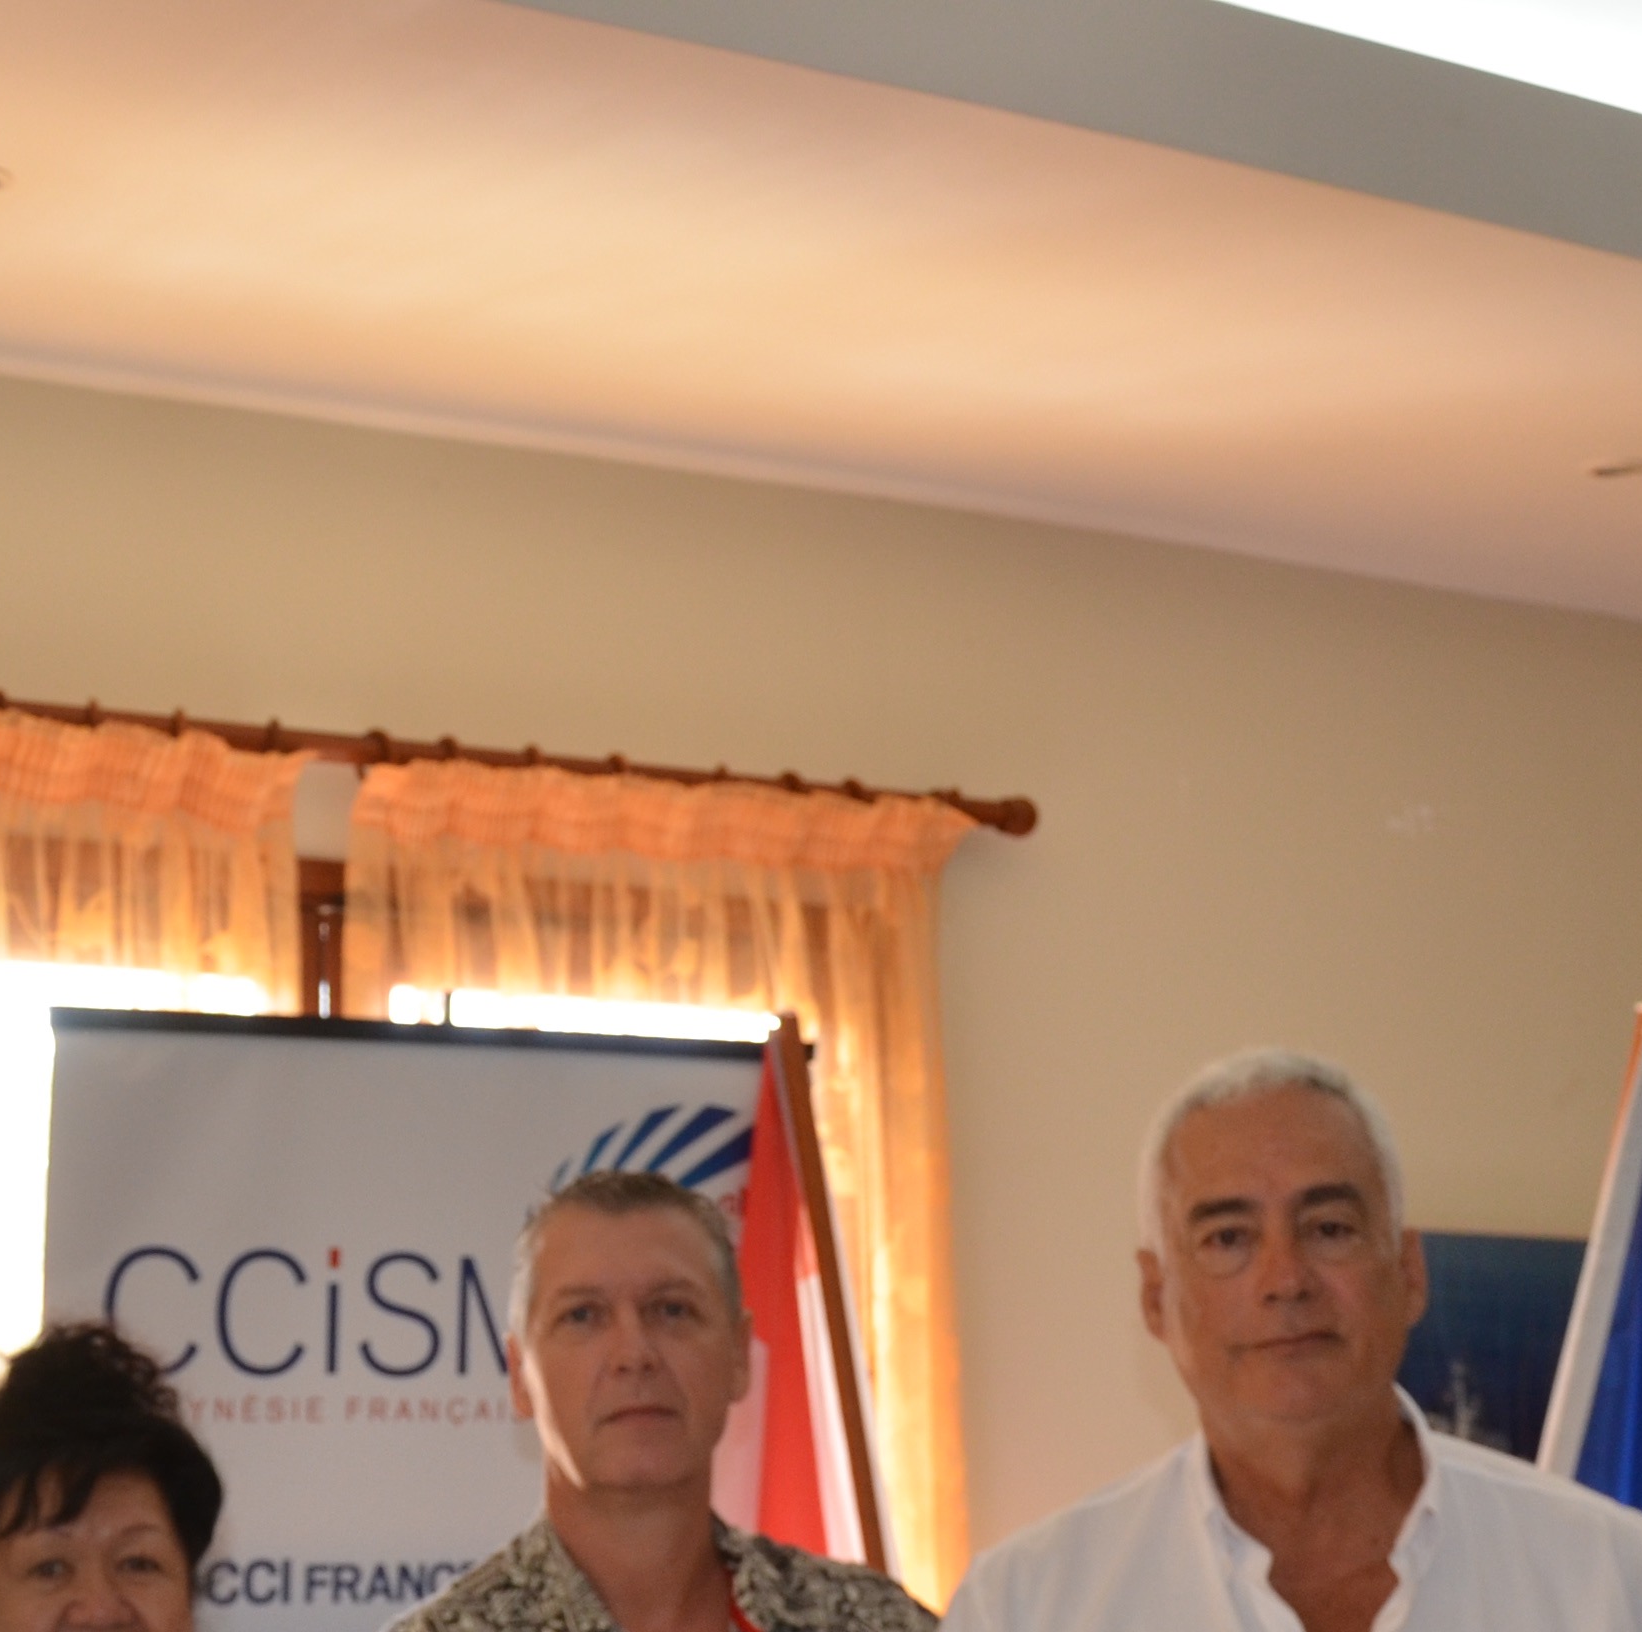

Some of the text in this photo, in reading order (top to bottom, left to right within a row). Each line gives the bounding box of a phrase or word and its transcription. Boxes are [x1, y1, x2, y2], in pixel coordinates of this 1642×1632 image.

[344, 1395, 508, 1428] FRANÇAI
[206, 1558, 471, 1606] CCI FRANC
